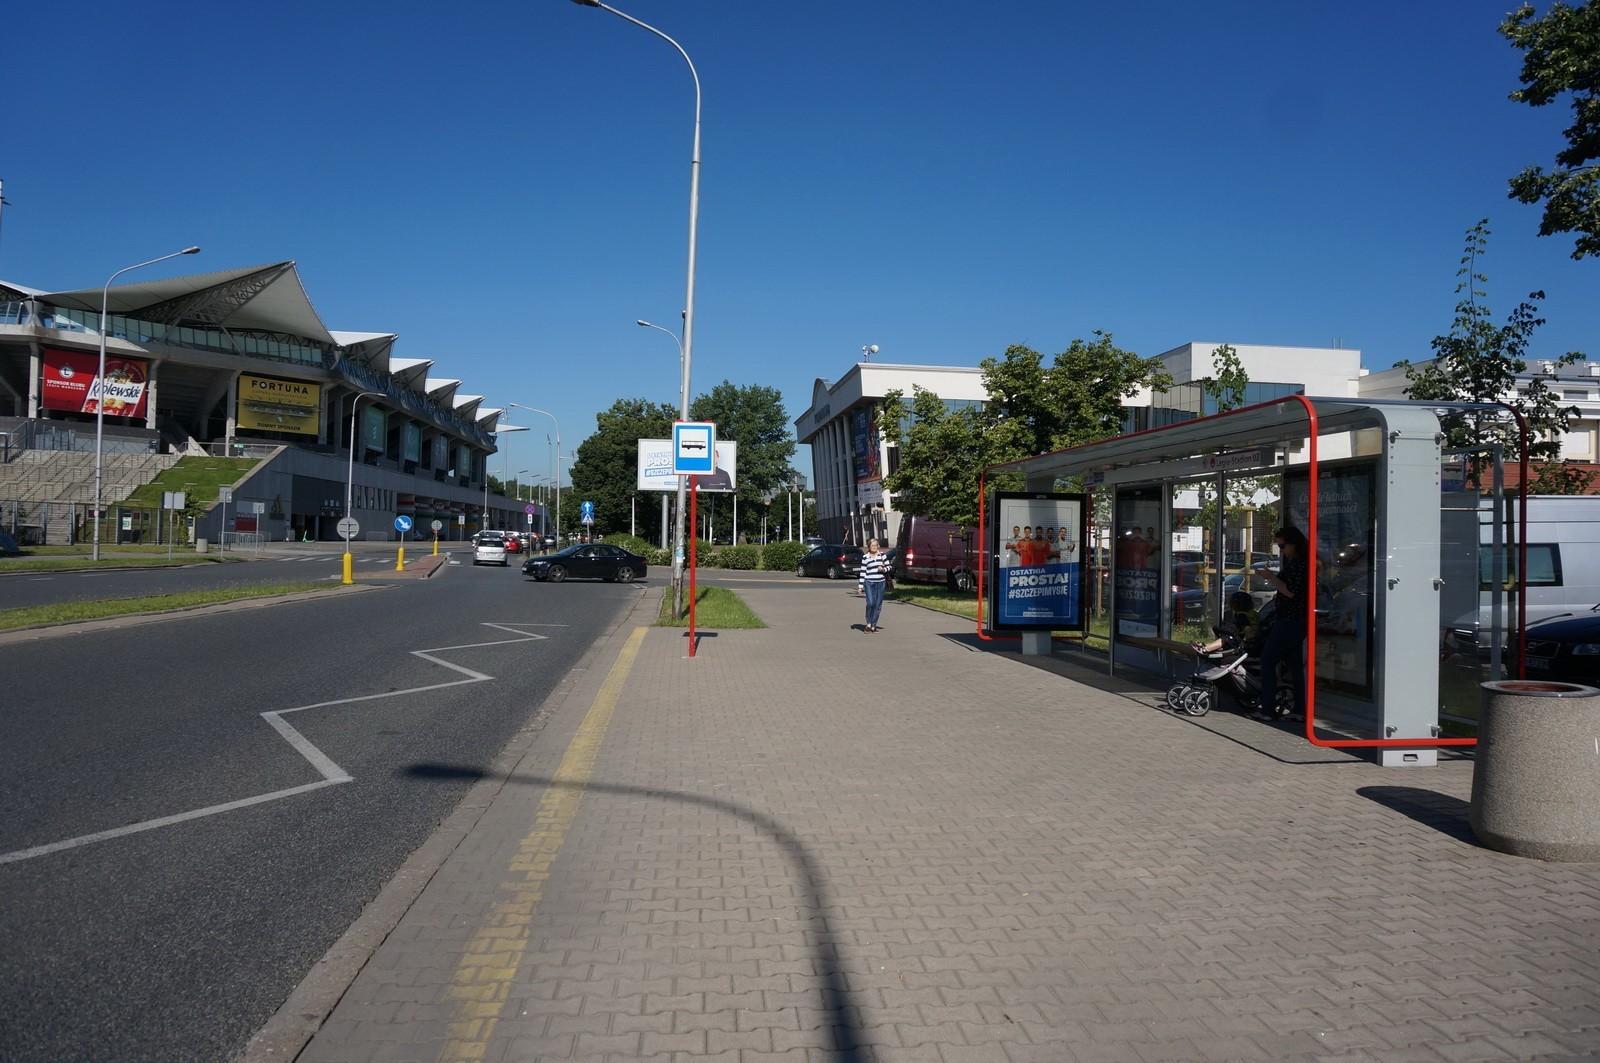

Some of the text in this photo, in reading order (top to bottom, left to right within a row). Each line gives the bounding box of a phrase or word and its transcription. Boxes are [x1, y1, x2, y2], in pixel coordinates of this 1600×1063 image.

[91, 381, 141, 398] Kólewskie
[251, 380, 309, 394] FORTUNA
[1010, 572, 1068, 588] PROSTA!
[1008, 585, 1068, 600] #SZCZEPIMYSIĘ
